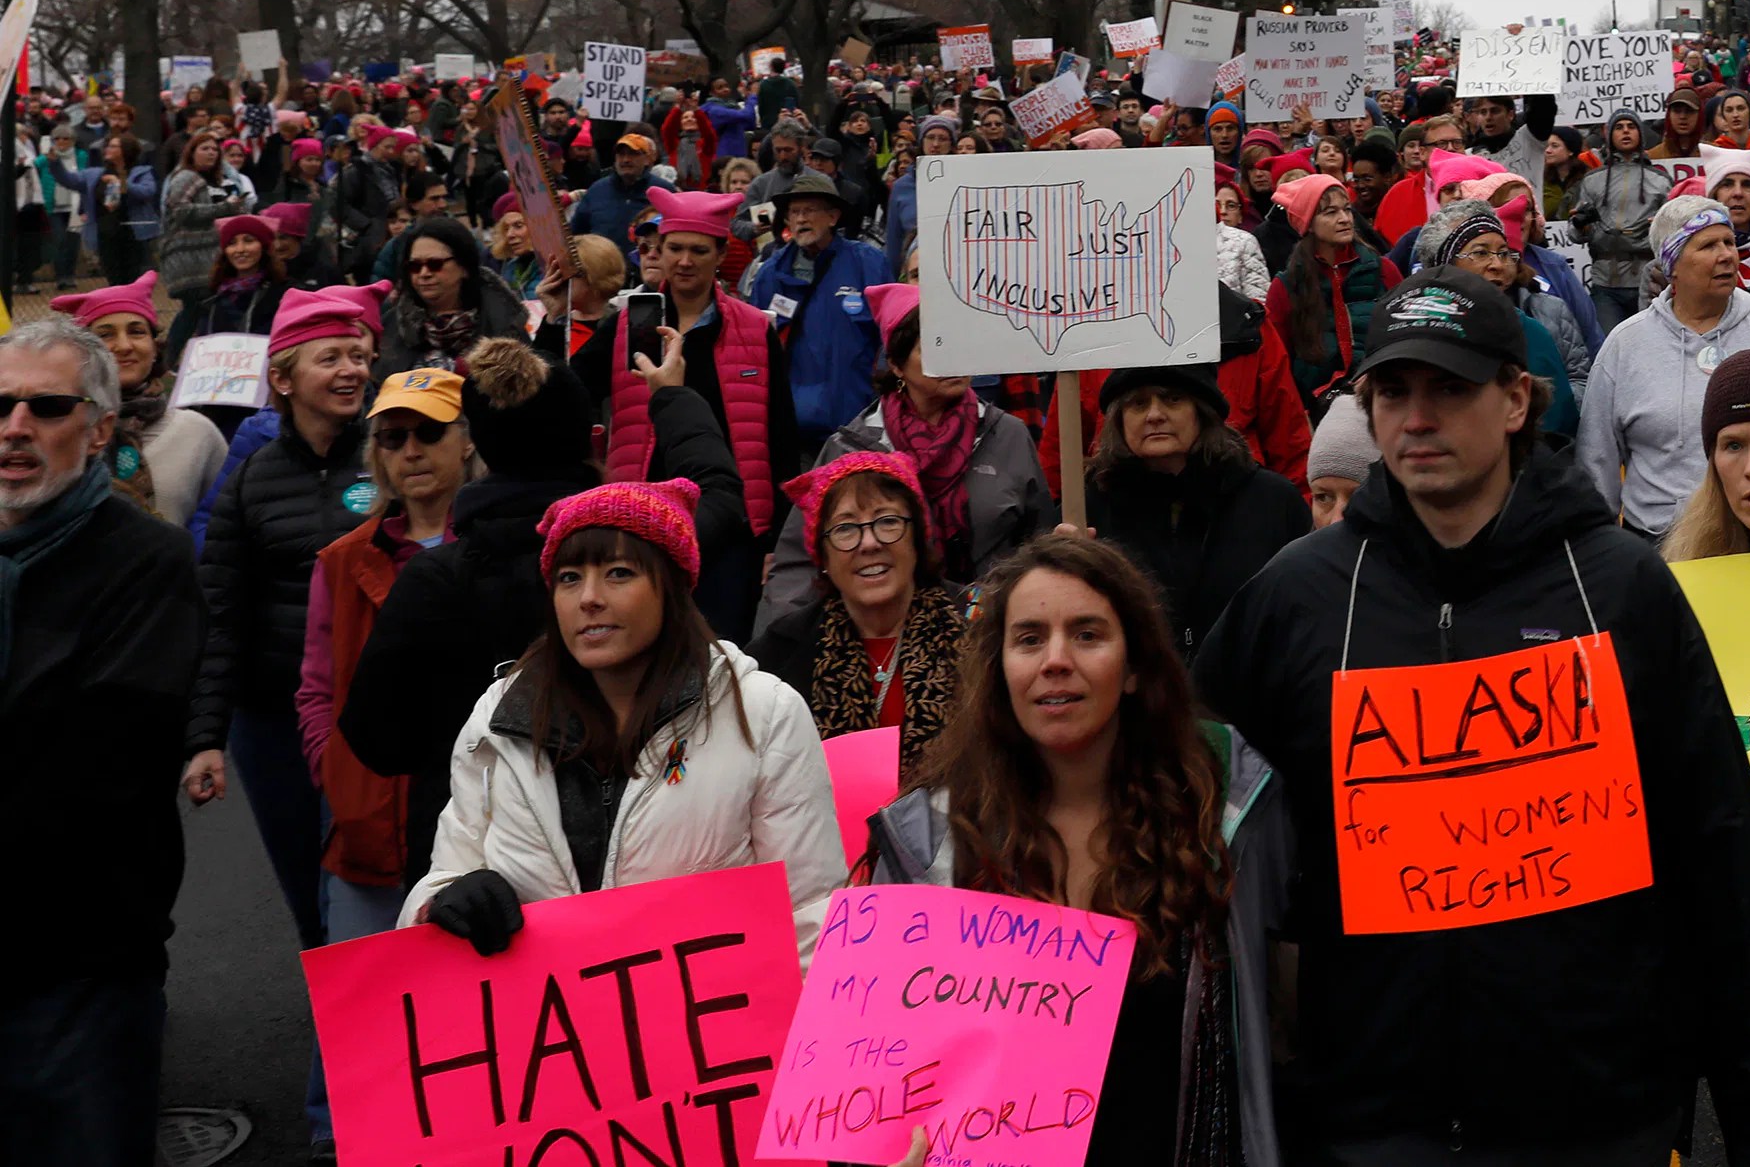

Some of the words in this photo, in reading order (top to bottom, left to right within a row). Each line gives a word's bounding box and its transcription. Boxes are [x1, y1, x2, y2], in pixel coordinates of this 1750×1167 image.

[1192, 14, 1212, 22] BLACK
[1257, 20, 1298, 36] RUSSIAN
[1305, 20, 1349, 34] PROVERB
[588, 44, 642, 65] STAND
[1184, 39, 1209, 48] MATTER
[1562, 35, 1613, 65] OVE
[1619, 34, 1670, 57] YOUR
[603, 64, 625, 82] UP
[1270, 59, 1290, 70] WITH
[1502, 59, 1517, 78] IS
[1566, 61, 1655, 82] NEIGHBOR
[586, 81, 640, 102] SPEAK
[1013, 90, 1048, 114] PEOPLE
[1277, 93, 1298, 109] GOOD
[1597, 84, 1625, 98] NOT
[602, 102, 624, 119] UP
[1019, 104, 1045, 125] FAITH
[1026, 97, 1091, 138] RESISTANCE
[964, 209, 1037, 239] FAIR
[1068, 231, 1149, 257] JUST
[972, 269, 1119, 315] INCLUSIVE
[1345, 651, 1600, 776] ALASKA
[1343, 788, 1390, 851] for
[1440, 778, 1639, 846] WOMEN'S
[1399, 845, 1572, 913] RIGHTS
[818, 893, 879, 951] AS
[903, 912, 929, 944] a
[961, 905, 1116, 966] WOMAN
[831, 975, 879, 1016] MY
[902, 966, 1093, 1026] COUNTRY
[403, 932, 773, 1138] HATE
[791, 1040, 818, 1070] IS
[776, 1060, 943, 1149] WHOLE
[925, 1088, 1096, 1156] WORLD
